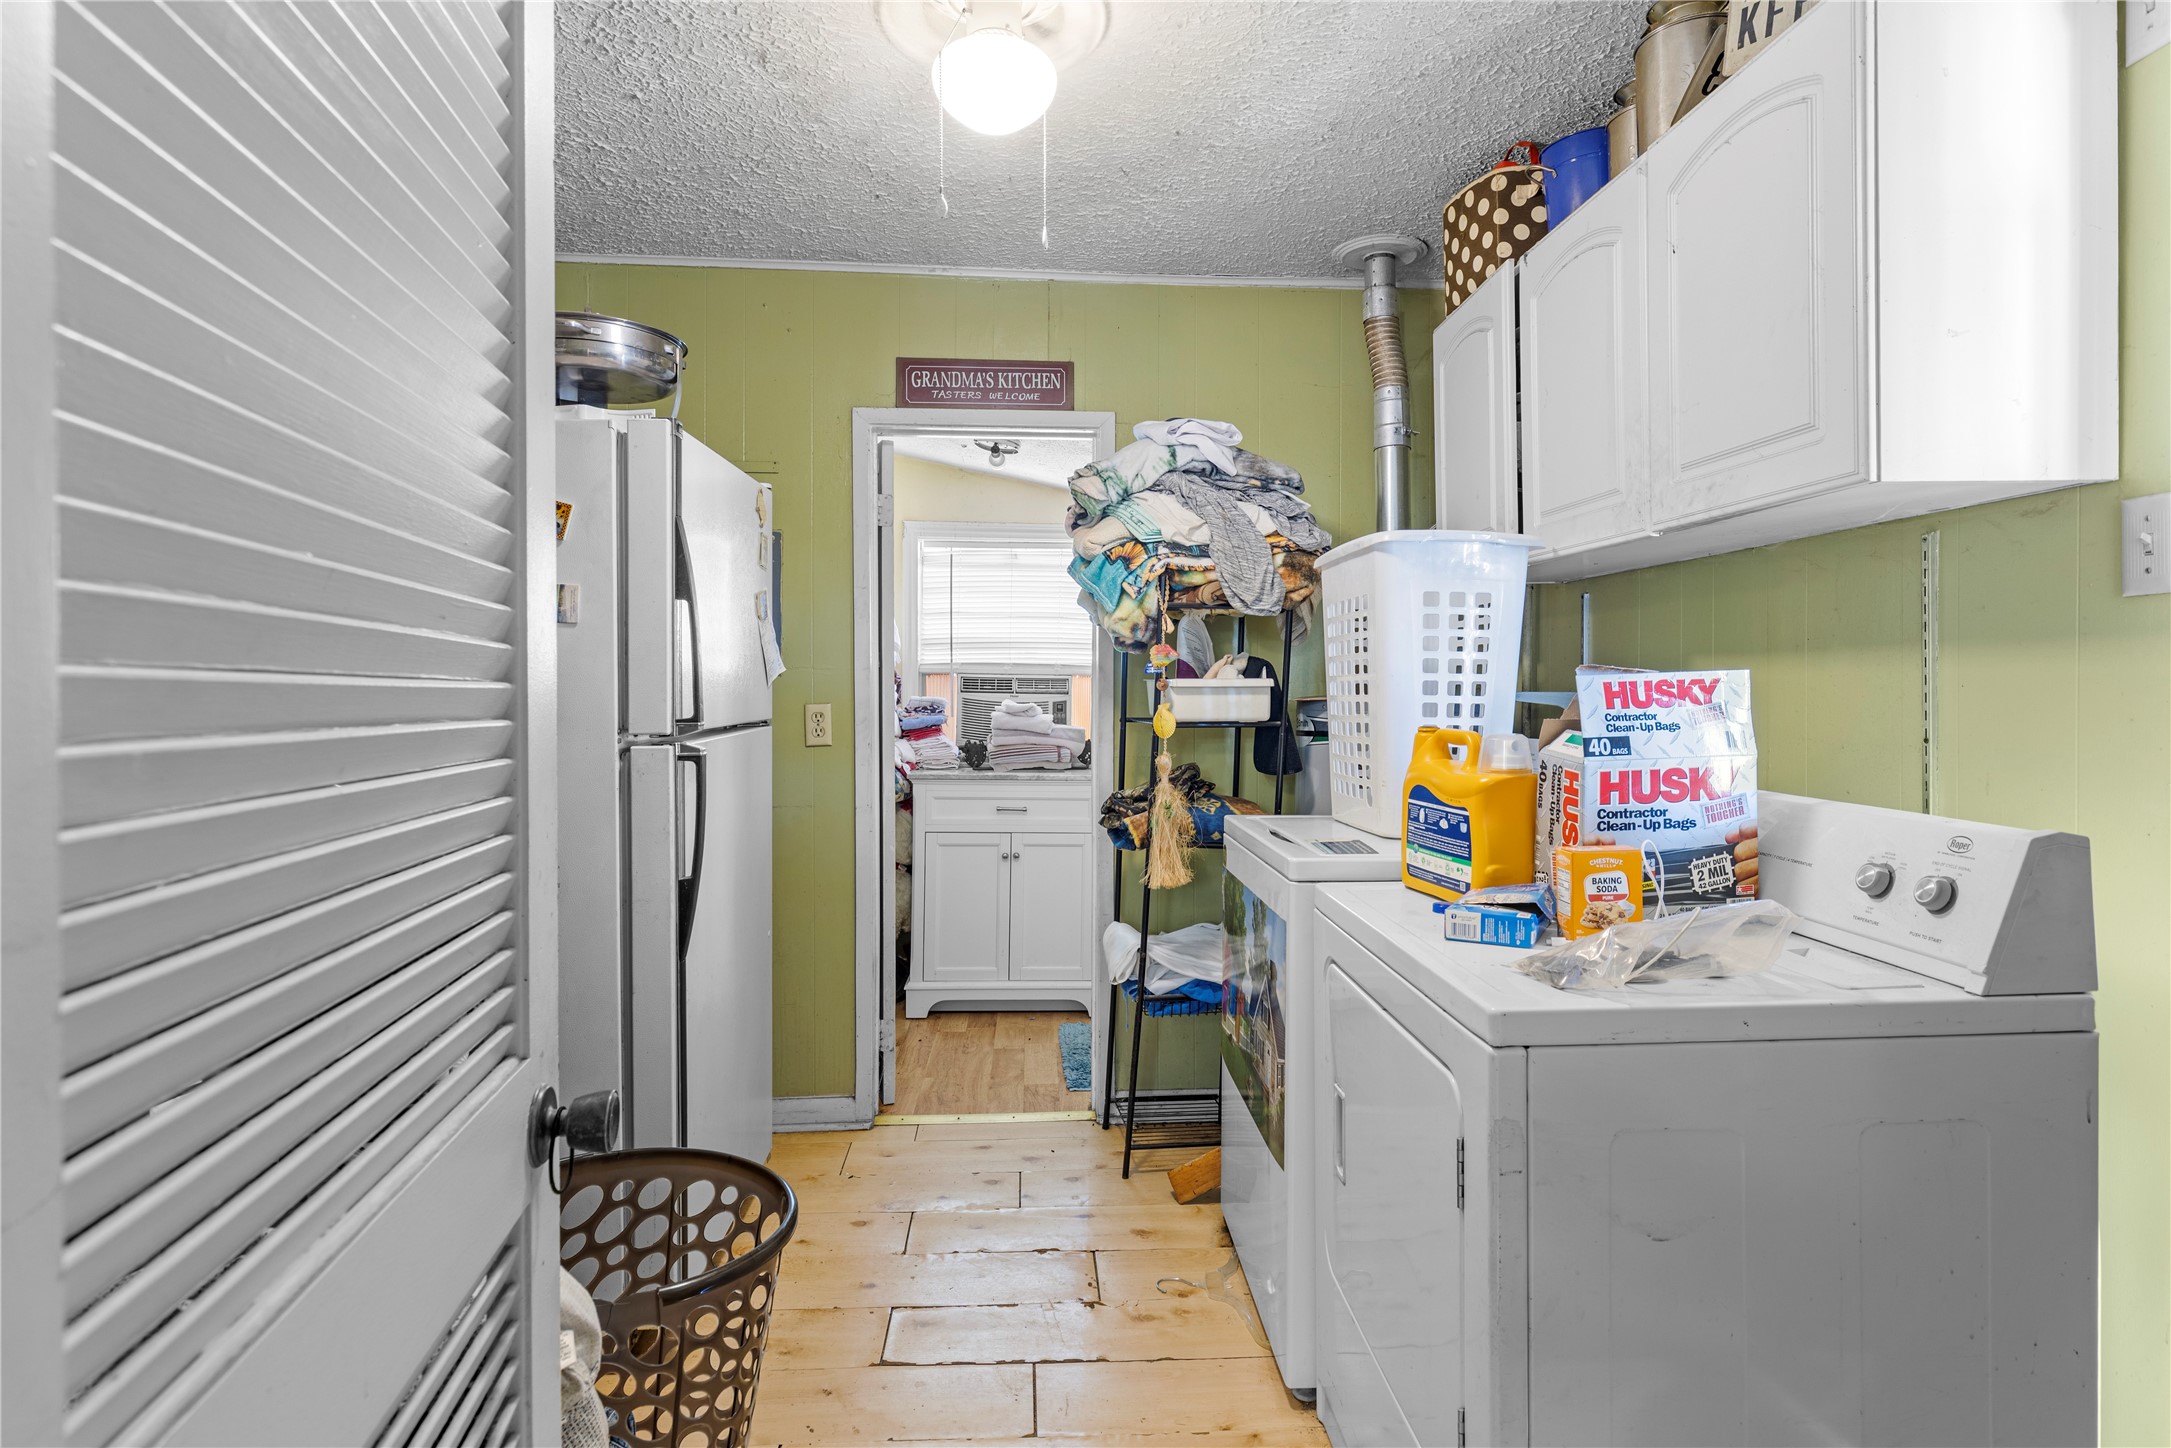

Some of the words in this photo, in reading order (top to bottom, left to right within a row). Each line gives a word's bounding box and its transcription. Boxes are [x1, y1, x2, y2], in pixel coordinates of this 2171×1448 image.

[911, 370, 994, 389] GRANDMA'S
[998, 372, 1061, 389] KITCHEN
[931, 390, 982, 400] TASTERS
[989, 391, 1041, 401] WELCOME
[1602, 678, 1722, 710] HUSKY
[1604, 713, 1658, 722] Contractor
[1655, 721, 1681, 732] Bags
[1588, 738, 1611, 756] 40
[1612, 747, 1629, 756] BAGS
[1539, 760, 1548, 782] 40
[1555, 765, 1563, 825] Contractor
[1562, 769, 1579, 847] HUS
[1704, 798, 1743, 814] NOTHING'S
[1597, 808, 1669, 819] Contractor
[1706, 806, 1745, 824] TOUGHER
[1663, 818, 1697, 831] Bags
[1949, 839, 1971, 851] Roper
[1589, 857, 1624, 866] CHESTNUT
[1693, 860, 1712, 870] HEAVY
[1712, 857, 1728, 866] DUTY
[1697, 870, 1705, 882] 2
[1708, 864, 1729, 880] MIL
[1591, 877, 1622, 885] BAKING
[1708, 877, 1731, 887] GALLON
[1596, 885, 1619, 893] SODA
[1853, 915, 1880, 926] TEMPERATURE
[1928, 936, 1943, 944] START
